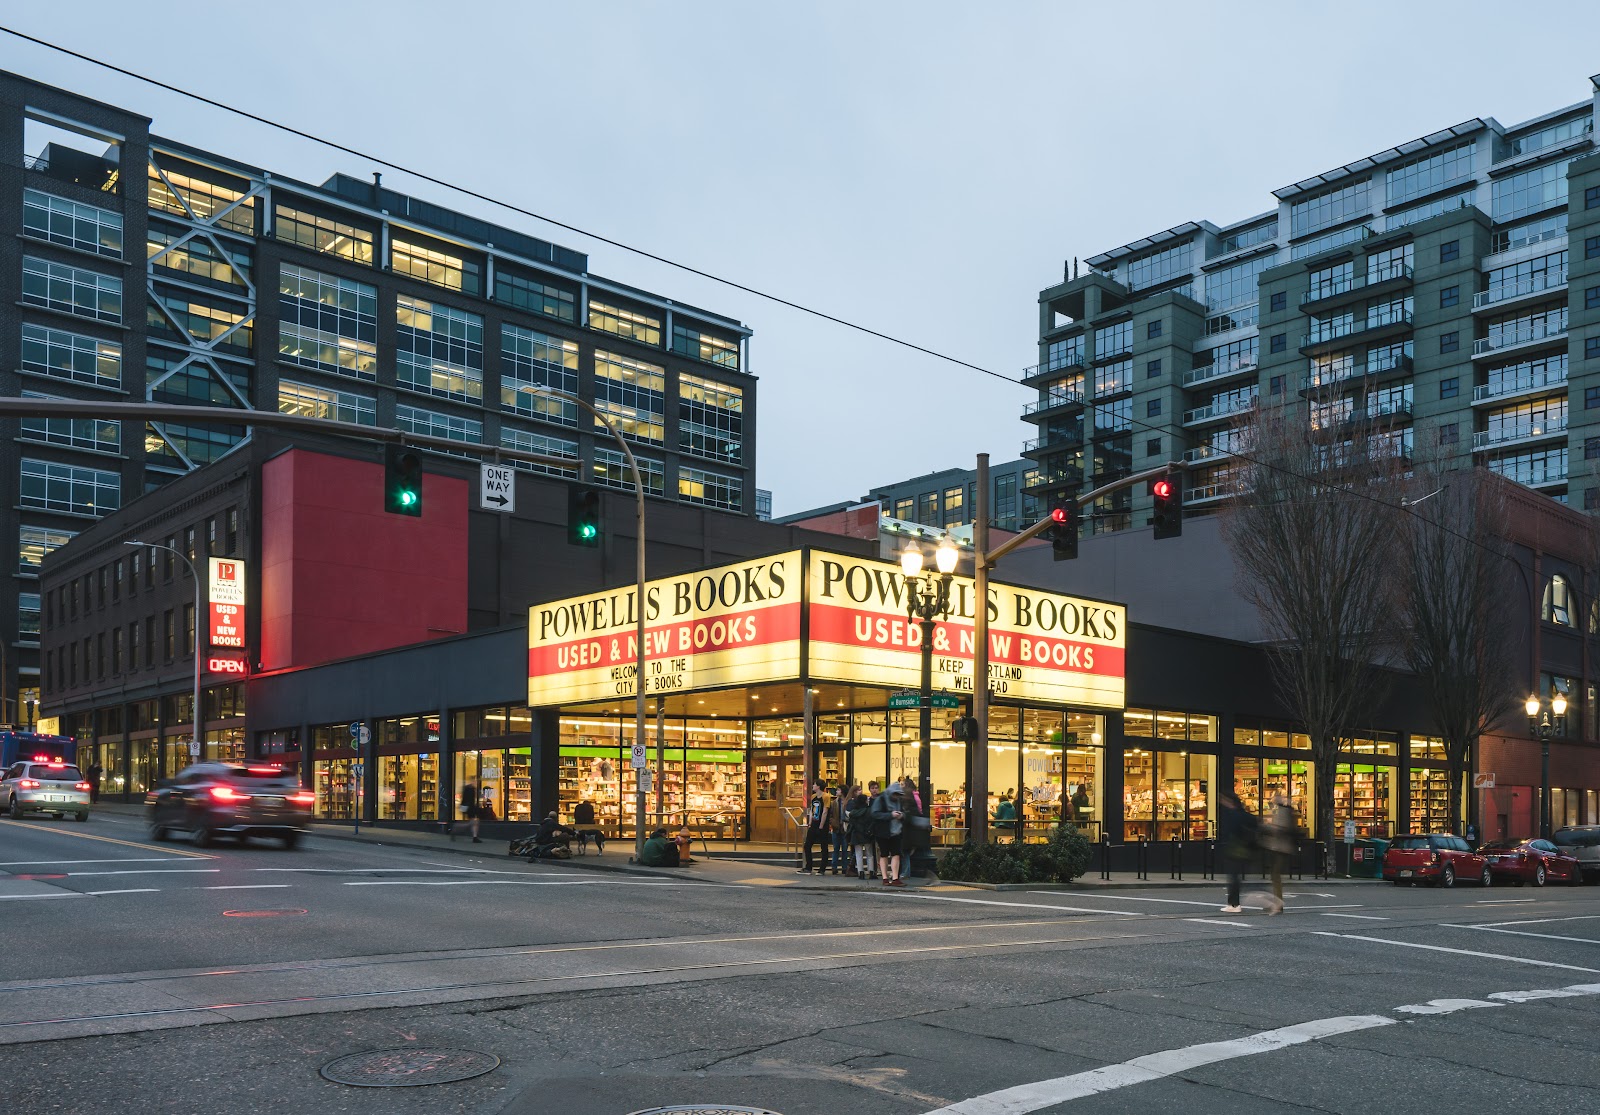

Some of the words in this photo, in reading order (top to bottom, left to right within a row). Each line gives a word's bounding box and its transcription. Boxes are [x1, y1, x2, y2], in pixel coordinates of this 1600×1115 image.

[487, 468, 509, 481] ONE
[486, 480, 510, 492] WAY
[673, 559, 786, 617] BOOKS
[216, 604, 237, 615] USED
[1013, 593, 1117, 641] BOOKS
[222, 614, 231, 624] &
[216, 625, 236, 636] NEW
[212, 635, 241, 647] BOOKS
[557, 644, 602, 669] USED
[610, 638, 621, 661] &
[627, 628, 671, 659] NEW
[678, 615, 757, 651] BOOKS
[855, 615, 922, 647] USED
[933, 626, 951, 651] &
[960, 629, 1012, 659] NW
[1020, 642, 1094, 670] BOOKS
[209, 658, 244, 673] OPEN
[611, 664, 638, 681] WELCOM
[651, 661, 662, 675] TO
[671, 658, 686, 673] THE
[939, 657, 964, 673] KEEP
[988, 664, 1022, 680] RTLAND
[616, 680, 633, 694] CITY
[655, 674, 683, 690] BOOKS
[954, 675, 973, 690] WEL
[990, 680, 1008, 693] EAD
[895, 698, 915, 706] Burnside
